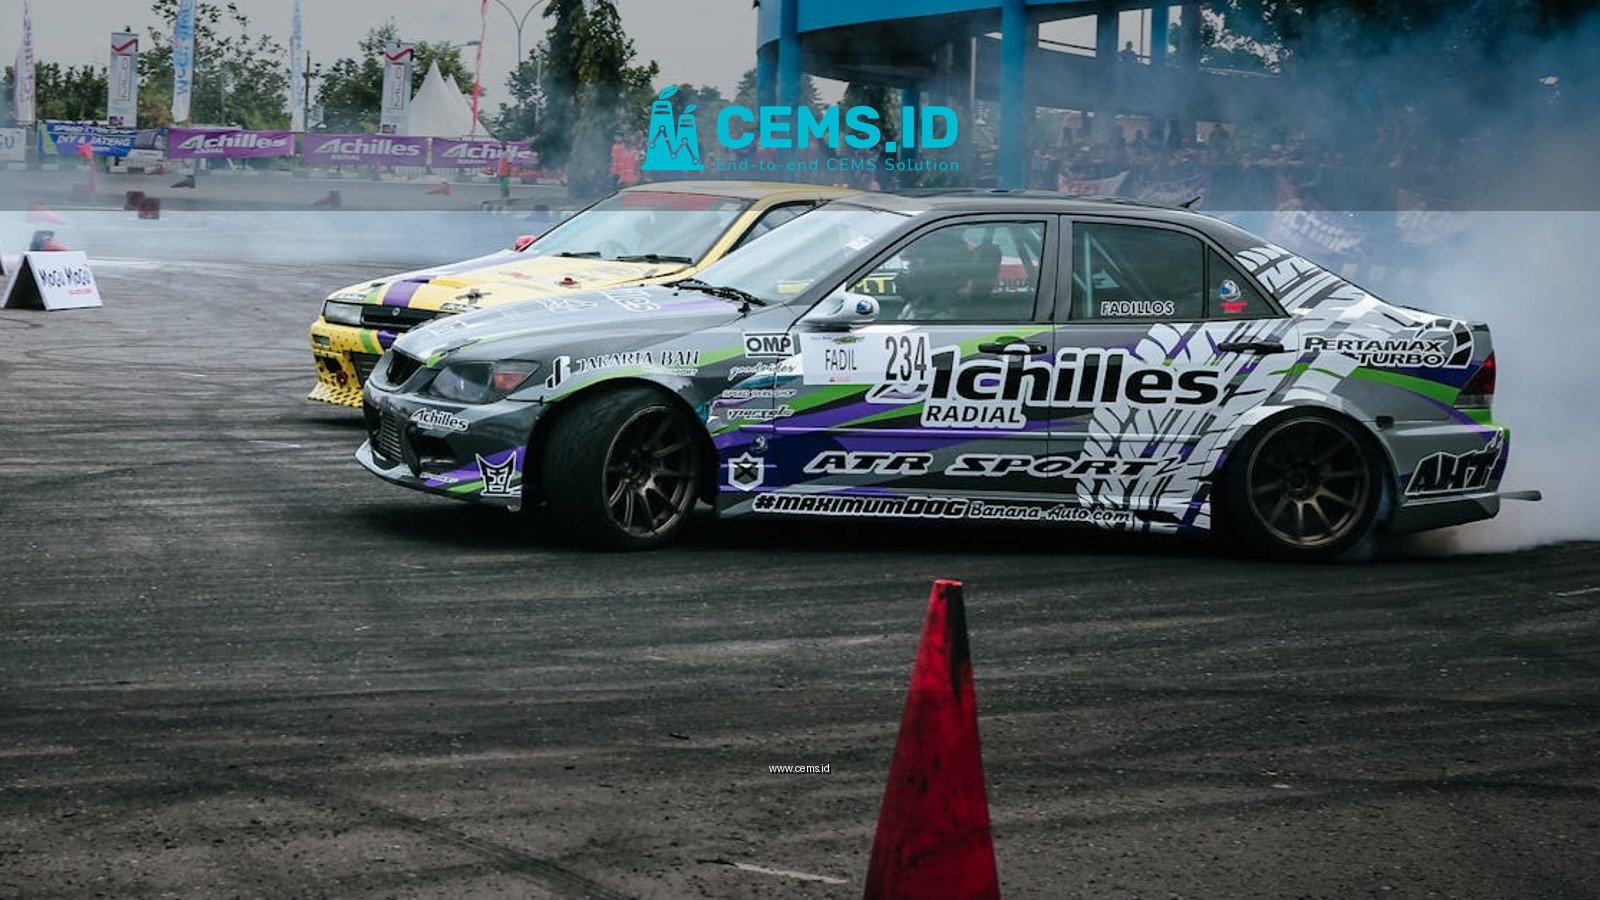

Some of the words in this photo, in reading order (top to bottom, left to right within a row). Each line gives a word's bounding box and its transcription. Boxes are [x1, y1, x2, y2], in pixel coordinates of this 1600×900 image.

[178, 134, 287, 149] Achilles
[315, 138, 421, 157] Achilles
[1101, 301, 1175, 316] FADILLOS
[746, 337, 791, 352] OMP
[1303, 336, 1445, 352] PERTAMAX
[576, 351, 653, 374] JAKARTA
[661, 349, 700, 367] BAN
[825, 349, 858, 371] FADIL
[885, 335, 927, 381] 234
[1356, 351, 1443, 367] TURBO
[867, 346, 1222, 406] Achilles
[410, 408, 469, 431] Achilles
[924, 404, 1022, 425] RADIAL
[803, 452, 933, 475] ATR
